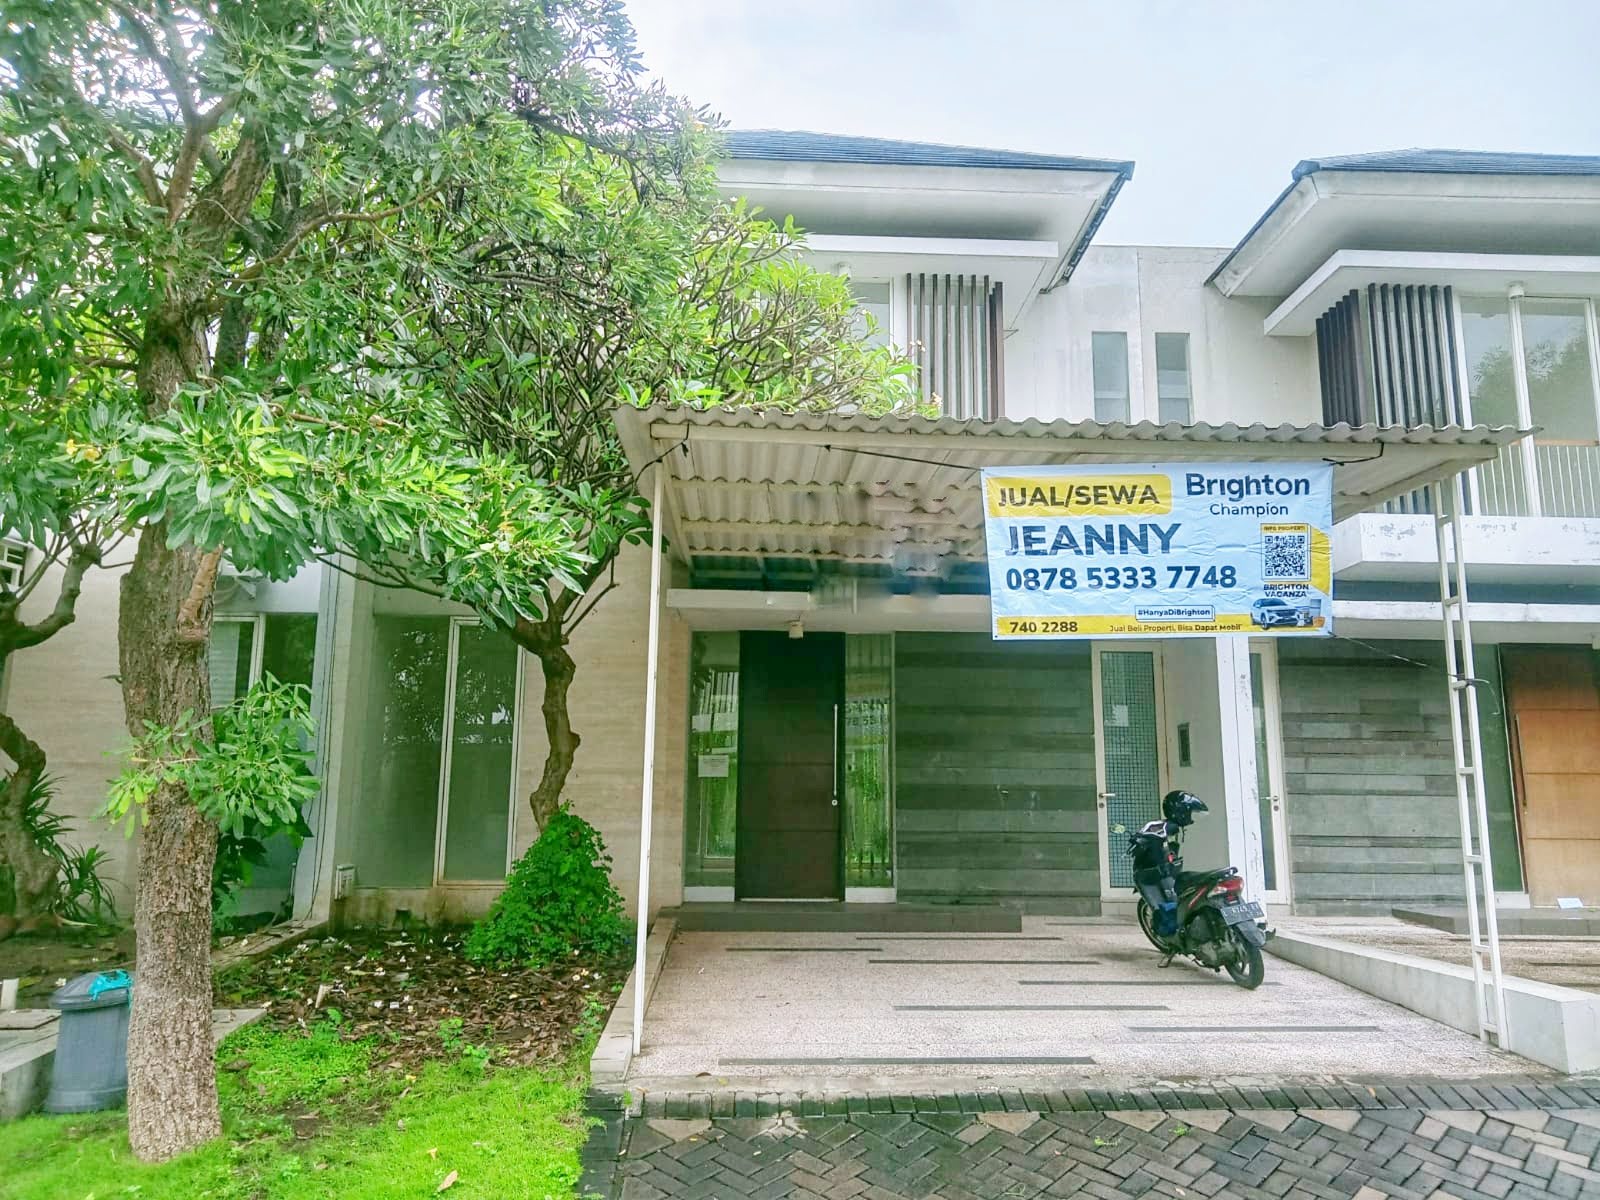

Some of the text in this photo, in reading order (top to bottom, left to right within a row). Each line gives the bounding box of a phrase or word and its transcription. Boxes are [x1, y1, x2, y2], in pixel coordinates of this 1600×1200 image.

[998, 485, 1160, 507] JUAL/SEWA
[1186, 473, 1310, 502] Brighton
[1210, 503, 1289, 517] Champion
[1005, 523, 1181, 556] JEANNY
[1006, 565, 1237, 591] 0878 5333 7748
[1138, 608, 1210, 616] #HanyaDiBrighton
[1009, 622, 1078, 633] 740 2288
[1194, 624, 1217, 632] Dapat
